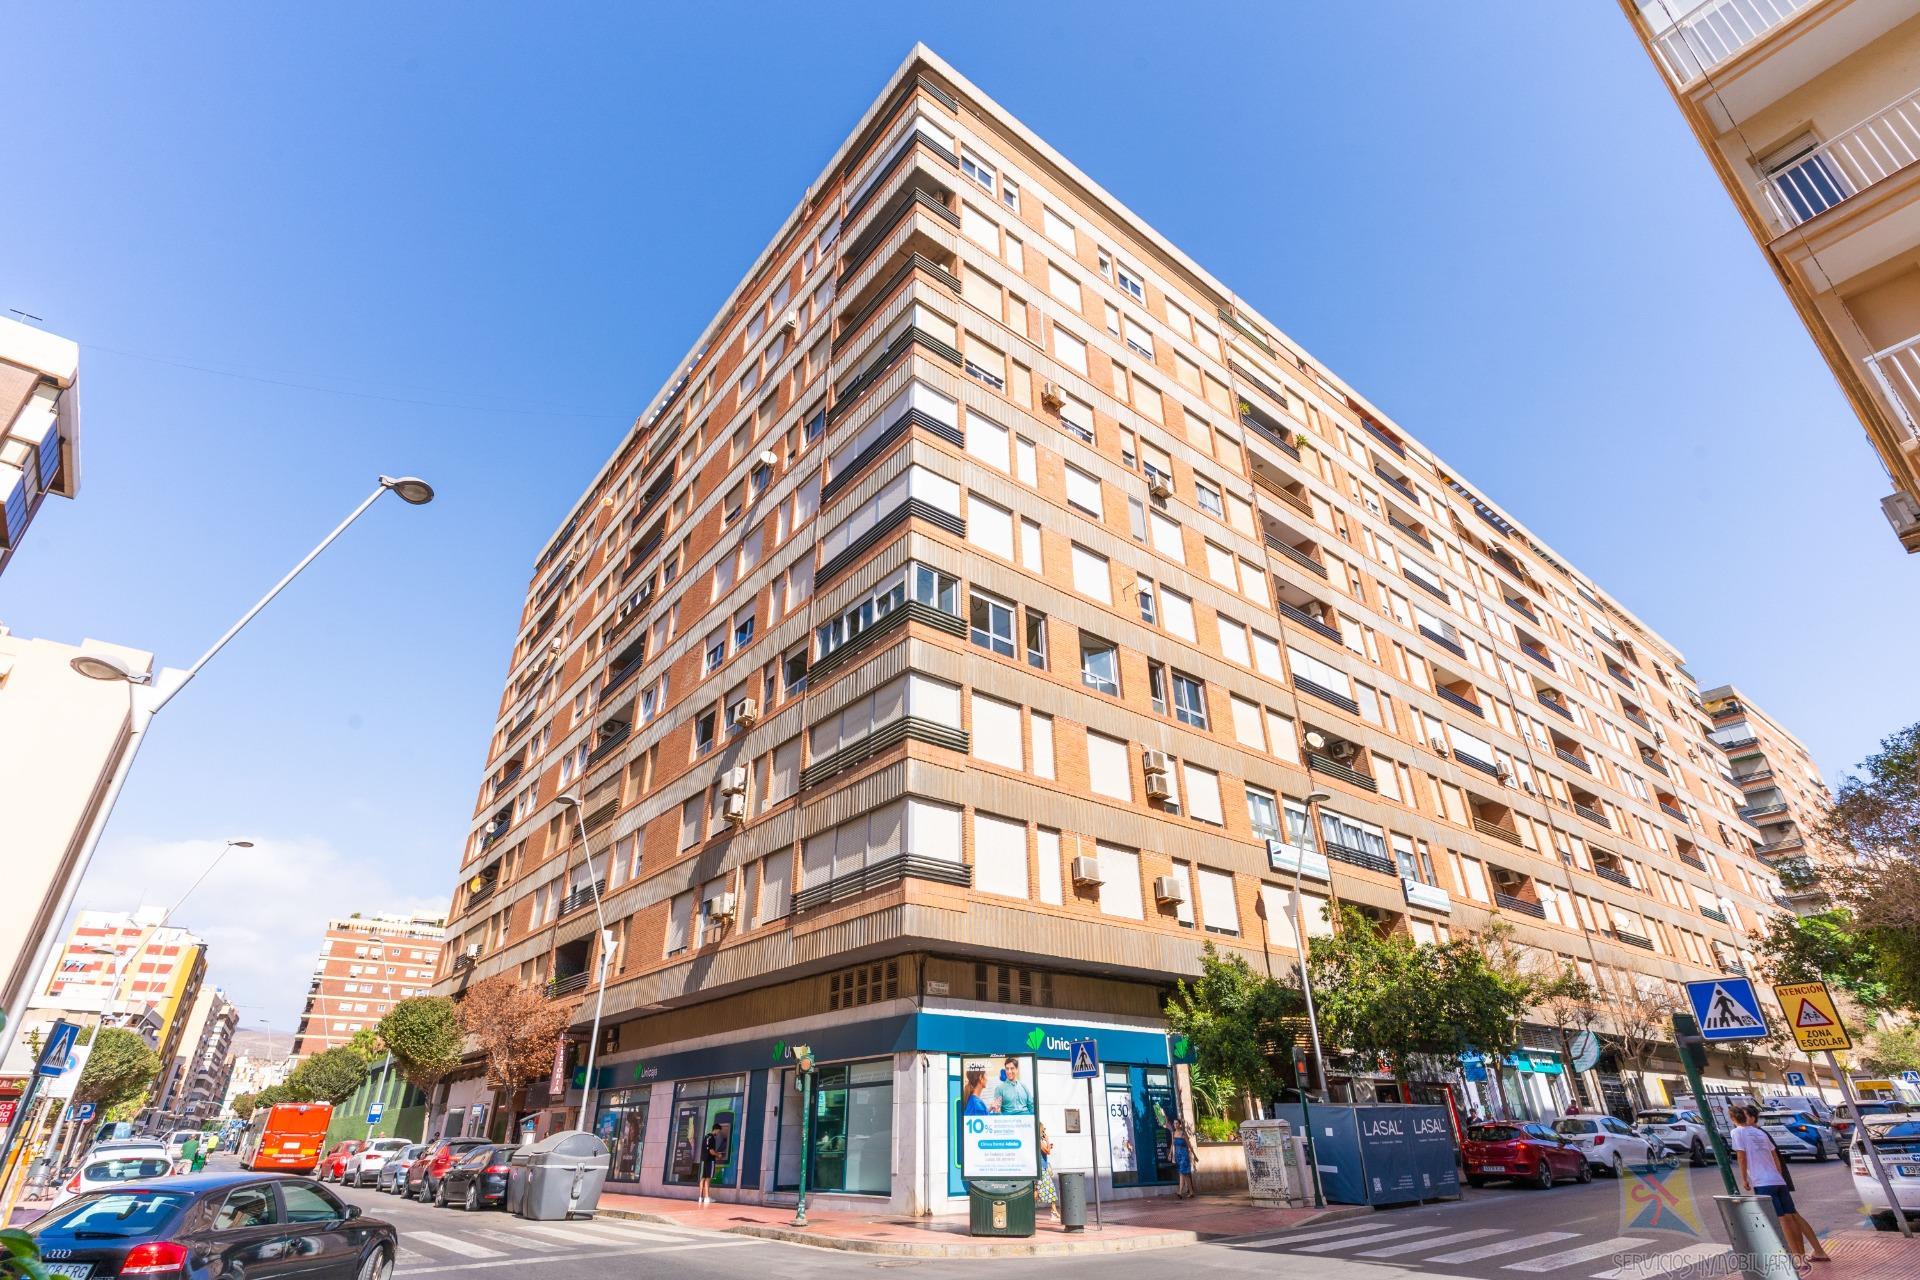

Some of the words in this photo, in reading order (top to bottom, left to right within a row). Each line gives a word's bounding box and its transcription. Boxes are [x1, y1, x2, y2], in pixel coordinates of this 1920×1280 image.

[1778, 985, 1824, 997] ATENCIÓN
[1806, 1030, 1833, 1038] ZONA
[1046, 1036, 1074, 1051] Unic
[1801, 1038, 1845, 1048] ESCOLAR
[1789, 1074, 1801, 1085] P
[77, 1105, 91, 1117] P
[1110, 1103, 1129, 1117] 630
